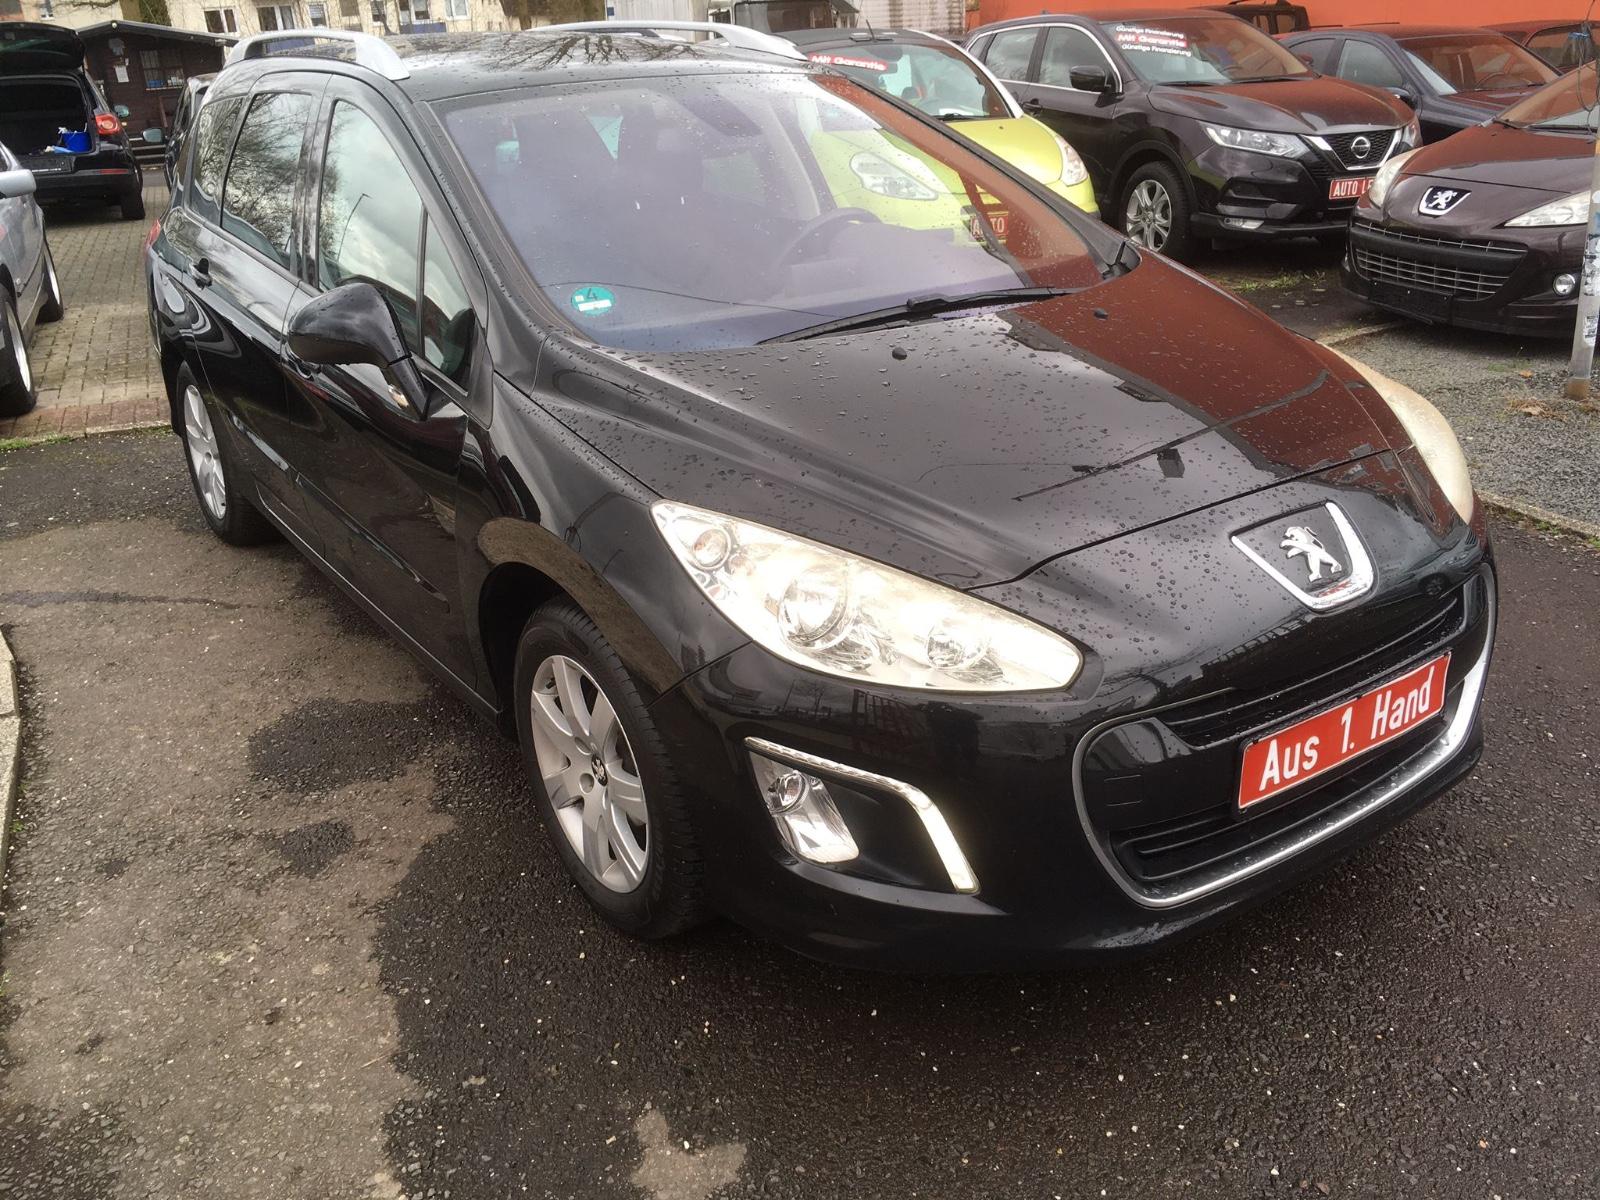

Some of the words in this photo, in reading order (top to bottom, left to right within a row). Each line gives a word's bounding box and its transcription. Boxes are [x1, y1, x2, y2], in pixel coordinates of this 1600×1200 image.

[1118, 34, 1136, 42] Mit
[1138, 35, 1185, 46] Garantie
[812, 55, 831, 64] Mit
[834, 57, 886, 70] Garantie
[1332, 181, 1358, 196] AUTO
[1258, 735, 1320, 792] Aus
[1340, 706, 1355, 754] 1.
[1370, 665, 1435, 741] Hand
